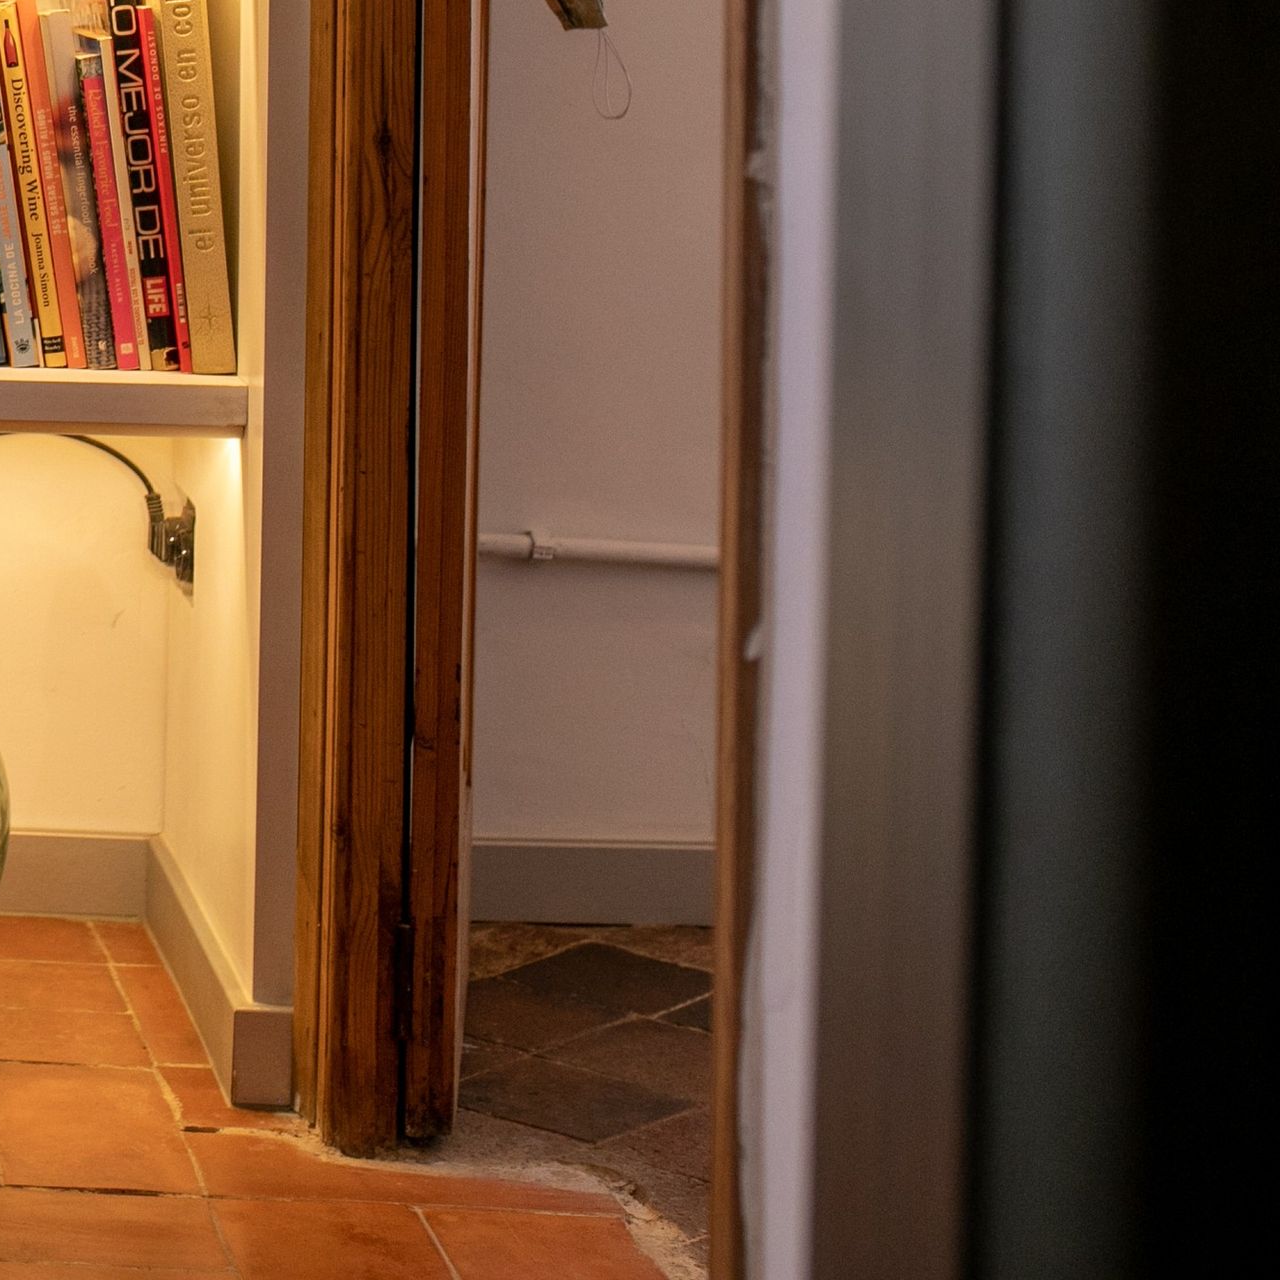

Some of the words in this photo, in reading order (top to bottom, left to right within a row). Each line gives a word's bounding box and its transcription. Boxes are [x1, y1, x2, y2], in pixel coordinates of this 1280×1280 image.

[147, 30, 160, 81] DONOSTI
[176, 50, 198, 82] en
[67, 105, 78, 123] the
[153, 87, 162, 100] DE
[10, 78, 33, 177] Discovering
[115, 47, 157, 194] MEJOR
[154, 117, 168, 154] PINTXOS
[70, 124, 84, 169] essential
[182, 95, 213, 218] universo
[26, 180, 40, 223] Wine
[74, 171, 92, 224] fingerfood
[31, 232, 45, 271] Joanna
[82, 225, 99, 275] cookbook
[135, 205, 165, 261] DE
[188, 228, 214, 254] el
[39, 272, 51, 309] Simon
[145, 277, 167, 316] LIFE
